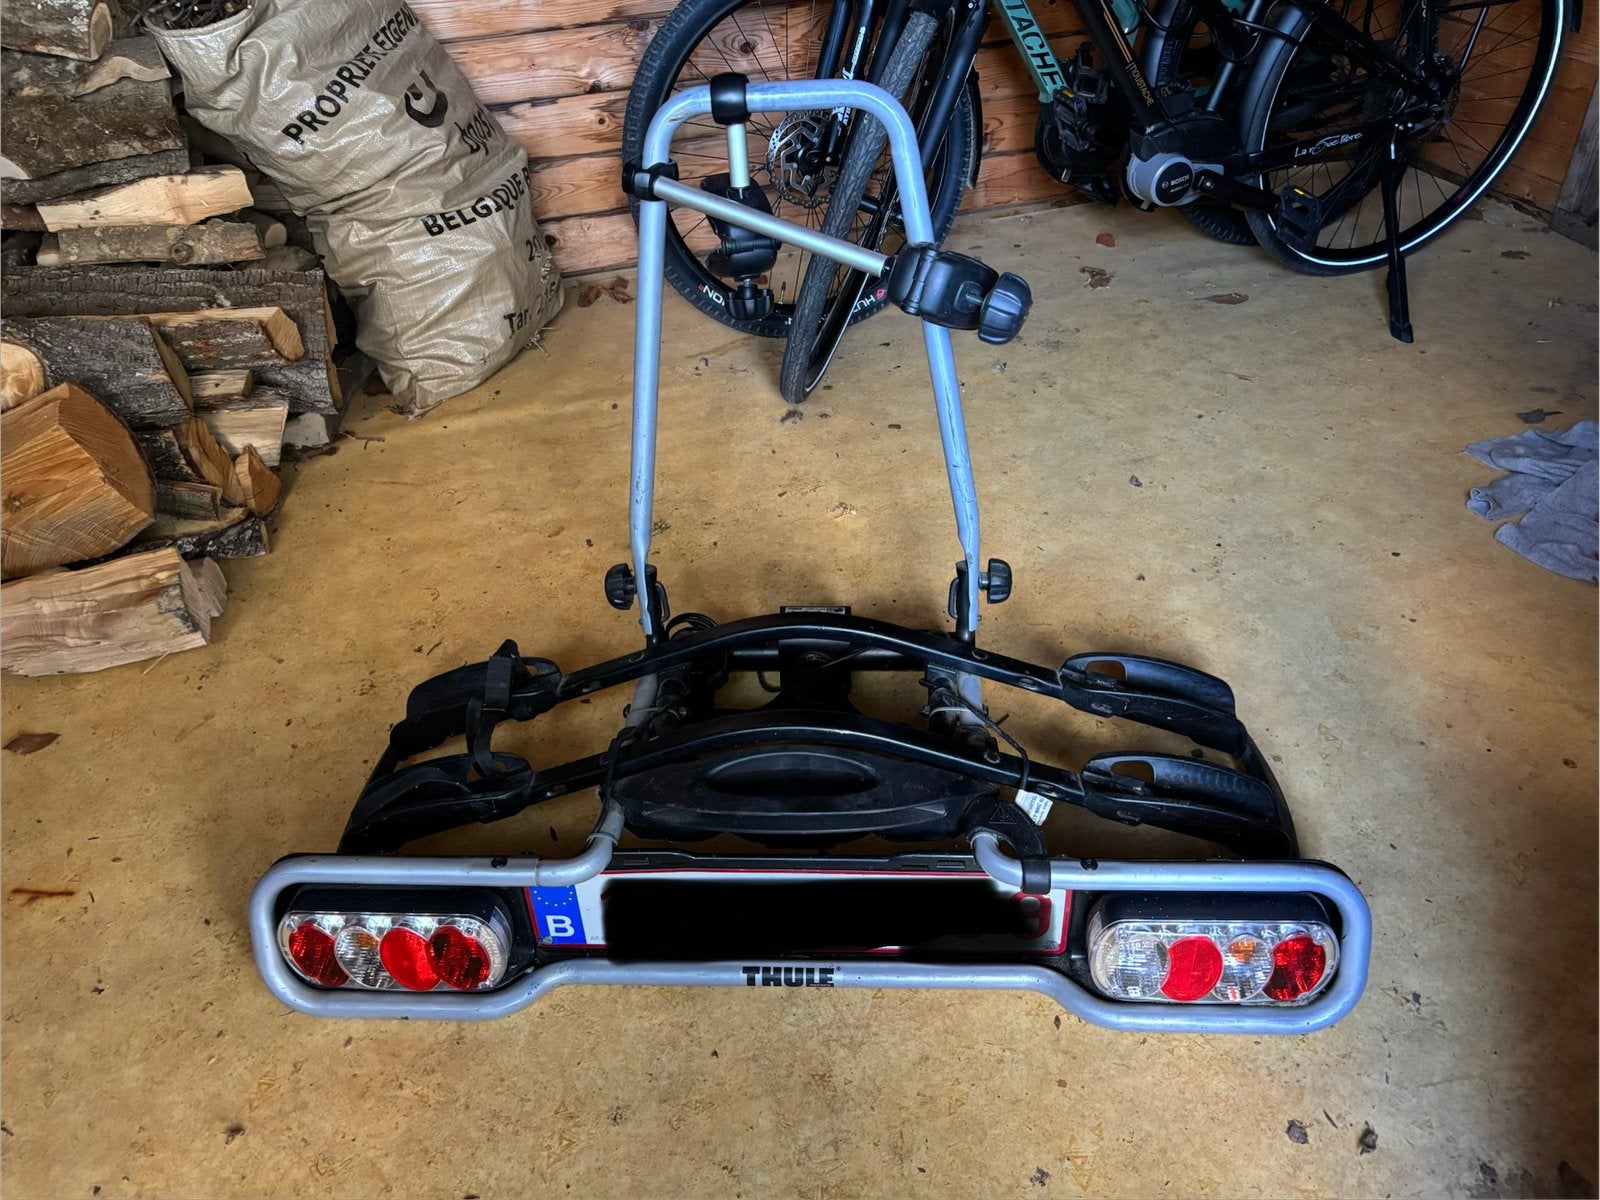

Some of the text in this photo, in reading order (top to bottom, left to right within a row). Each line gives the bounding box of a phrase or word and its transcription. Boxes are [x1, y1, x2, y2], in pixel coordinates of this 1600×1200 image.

[1125, 61, 1155, 107] MOUSTACHE
[1170, 174, 1190, 186] BOSCH
[420, 172, 525, 237] BELGIQUE
[545, 914, 575, 937] B
[742, 965, 835, 987] THULE
